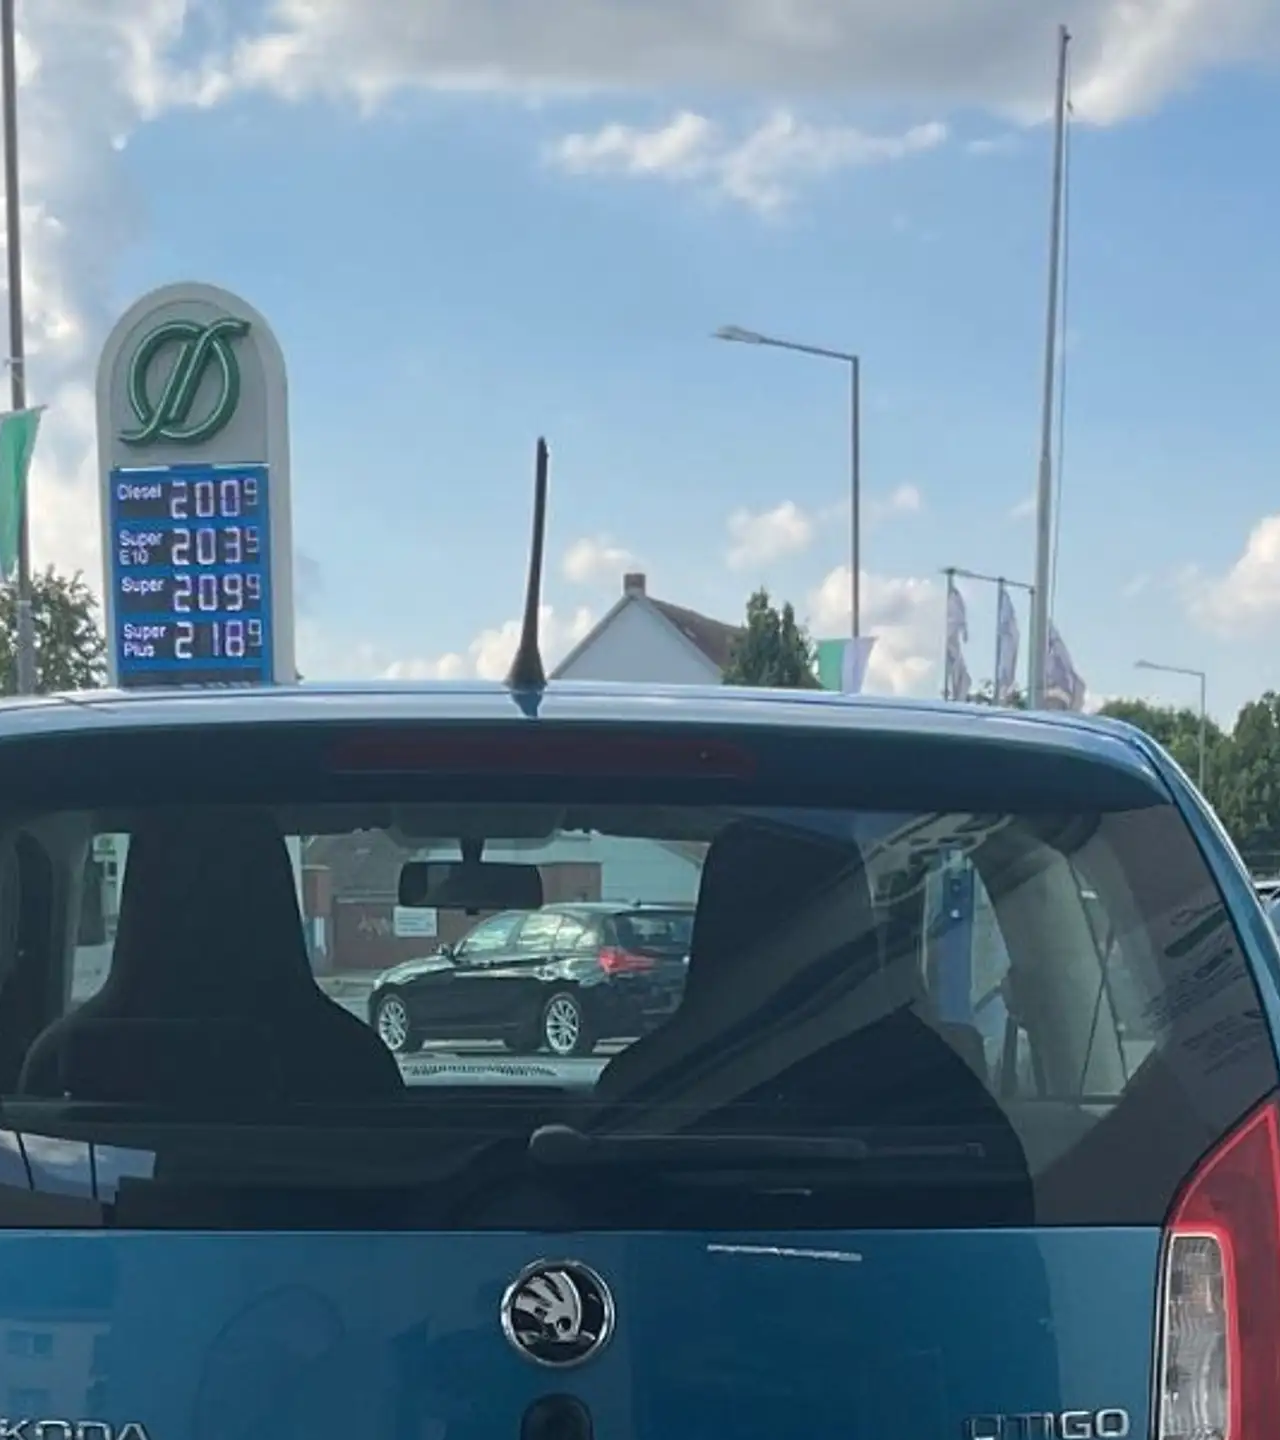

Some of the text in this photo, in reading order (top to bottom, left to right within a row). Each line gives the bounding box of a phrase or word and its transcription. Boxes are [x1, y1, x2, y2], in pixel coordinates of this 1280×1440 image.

[117, 483, 161, 500] Diesel
[120, 530, 163, 550] Super
[120, 550, 149, 566] E10
[121, 576, 164, 596] Super
[124, 623, 166, 641] Super
[124, 641, 155, 658] Plus
